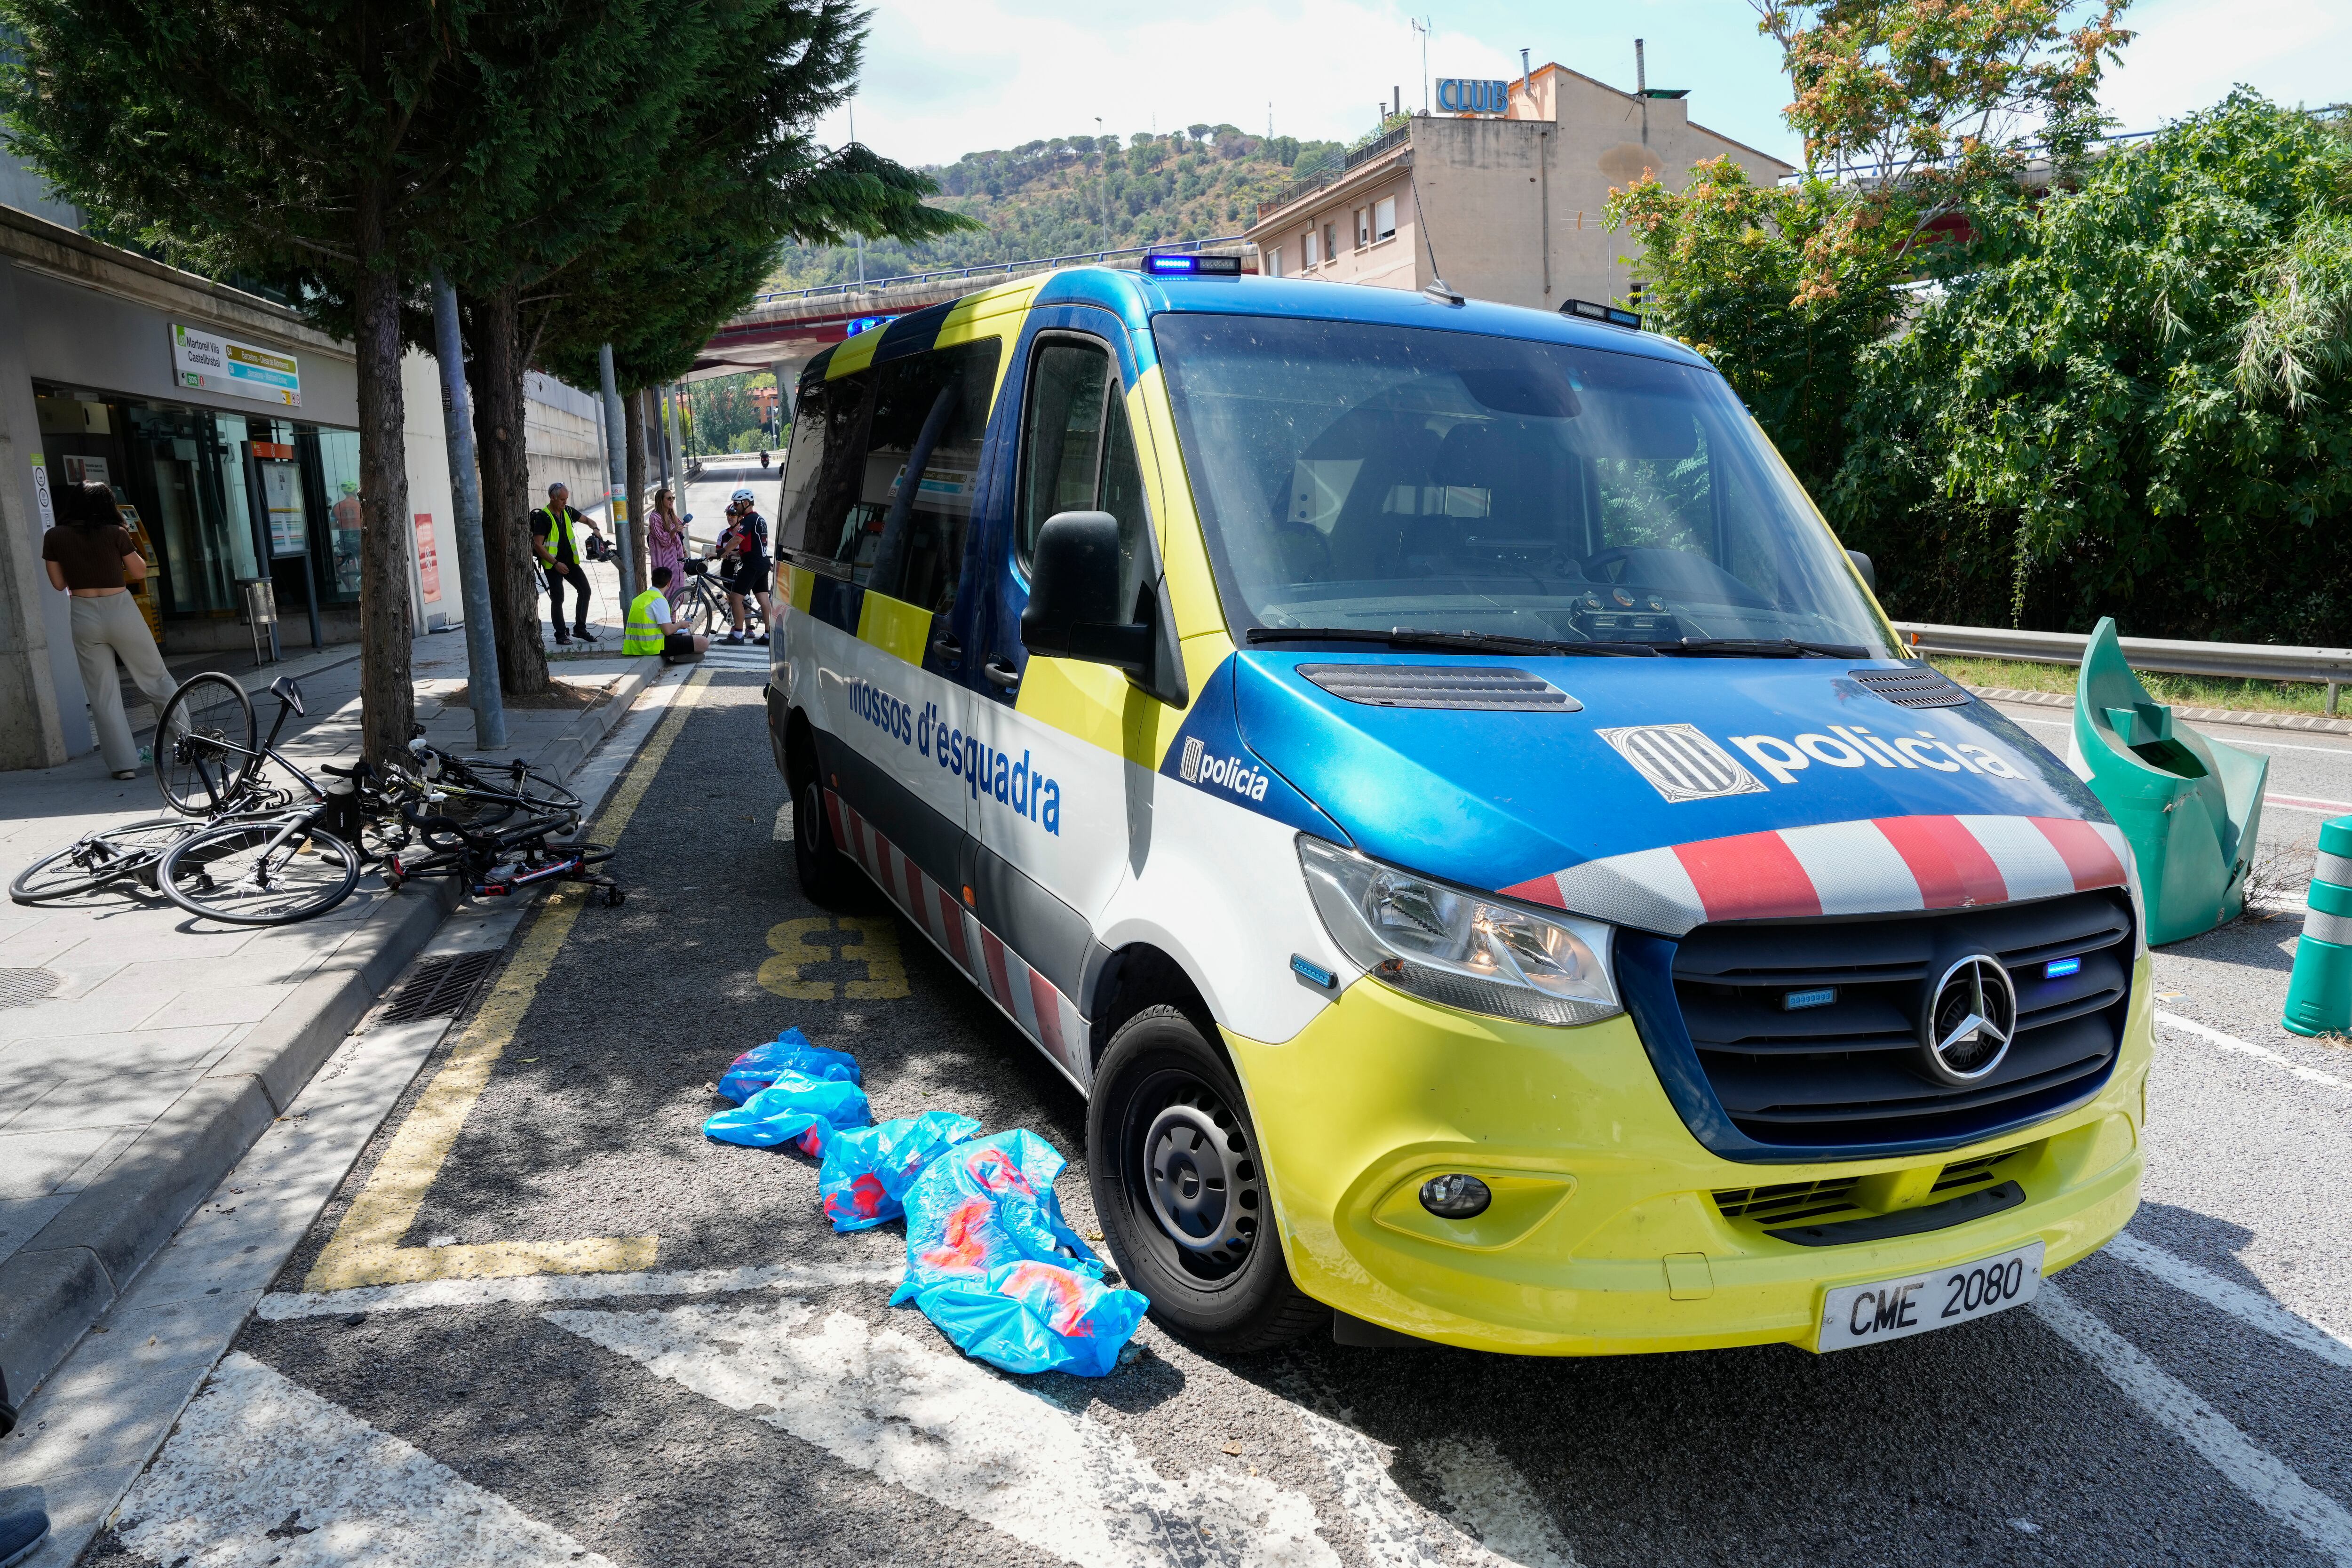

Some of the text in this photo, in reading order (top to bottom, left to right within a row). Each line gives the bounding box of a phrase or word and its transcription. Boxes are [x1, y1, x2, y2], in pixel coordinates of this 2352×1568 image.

[1438, 79, 1508, 111] CLUB
[186, 336, 220, 354] Martorell Vila
[226, 346, 232, 357] S4
[188, 350, 221, 368] Castellbisbal
[241, 350, 258, 362] Barcelona
[260, 355, 270, 366] Olesa
[270, 358, 274, 366] de
[188, 374, 198, 384] SOS
[849, 675, 1060, 837] mossos d'esquadra
[1728, 724, 2030, 783] policia
[1199, 753, 1269, 801] policia
[1850, 1258, 2023, 1336] CME 2080
